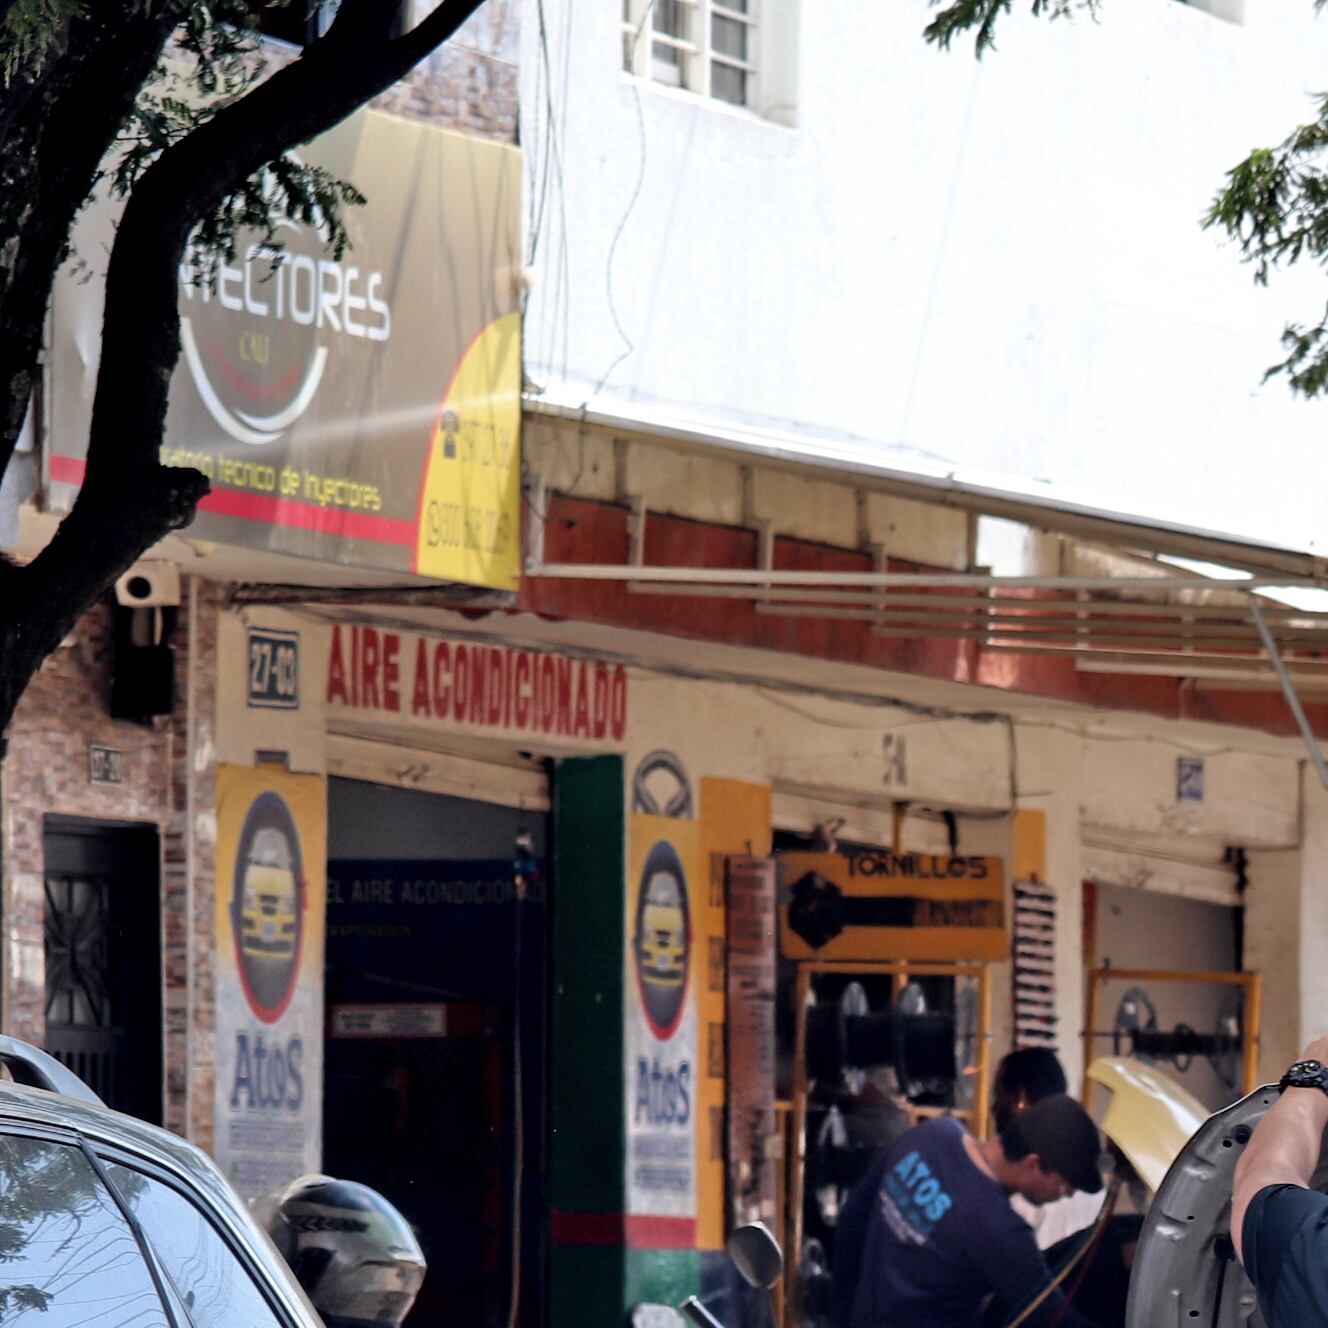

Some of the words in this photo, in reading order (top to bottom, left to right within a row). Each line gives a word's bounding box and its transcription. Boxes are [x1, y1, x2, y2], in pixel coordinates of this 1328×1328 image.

[280, 466, 298, 495] de
[326, 623, 401, 712] AIRE
[410, 636, 628, 742] ACONDICIONADO
[847, 851, 990, 880] TORNILLOS
